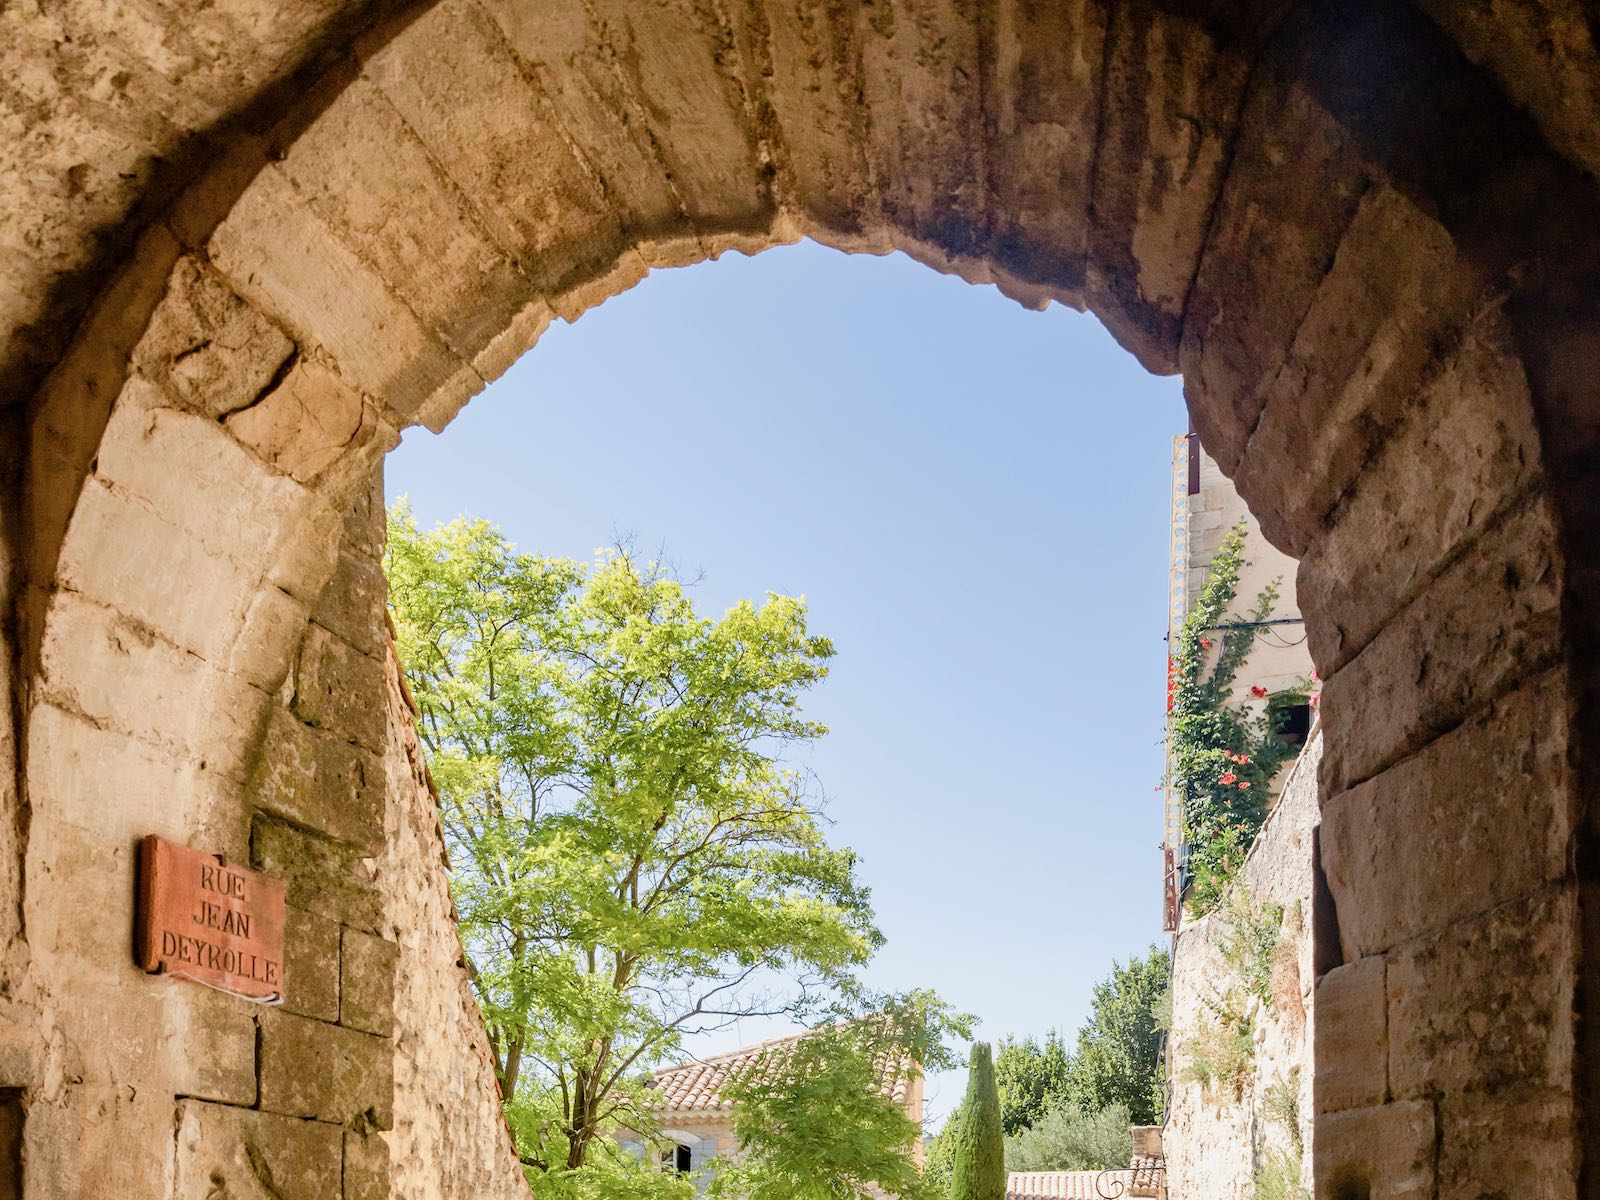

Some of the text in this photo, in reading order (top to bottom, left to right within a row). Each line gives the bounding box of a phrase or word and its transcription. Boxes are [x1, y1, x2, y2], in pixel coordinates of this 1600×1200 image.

[201, 863, 246, 900] RUE
[193, 901, 250, 939] JEAN
[162, 930, 278, 985] DEYROLLE
